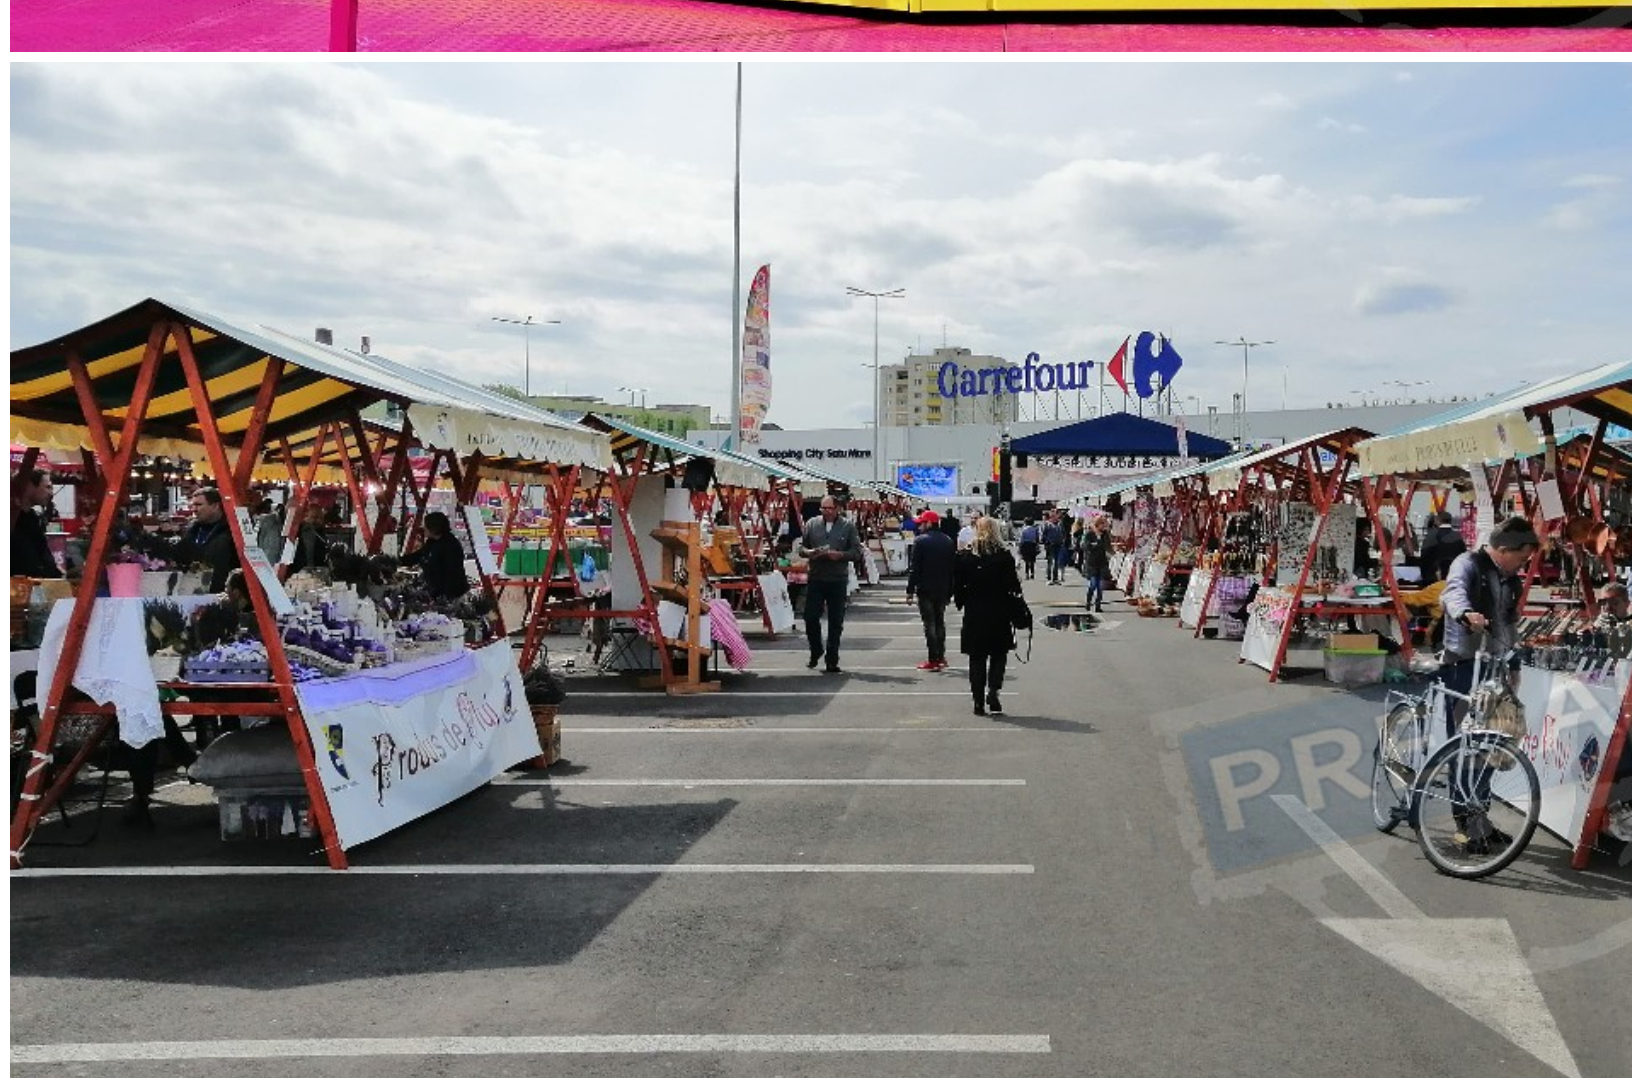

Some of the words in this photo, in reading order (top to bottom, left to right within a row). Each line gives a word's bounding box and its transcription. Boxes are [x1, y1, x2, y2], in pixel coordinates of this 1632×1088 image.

[937, 351, 1095, 399] Carrefour
[758, 448, 803, 460] Shopping
[805, 448, 824, 459] City
